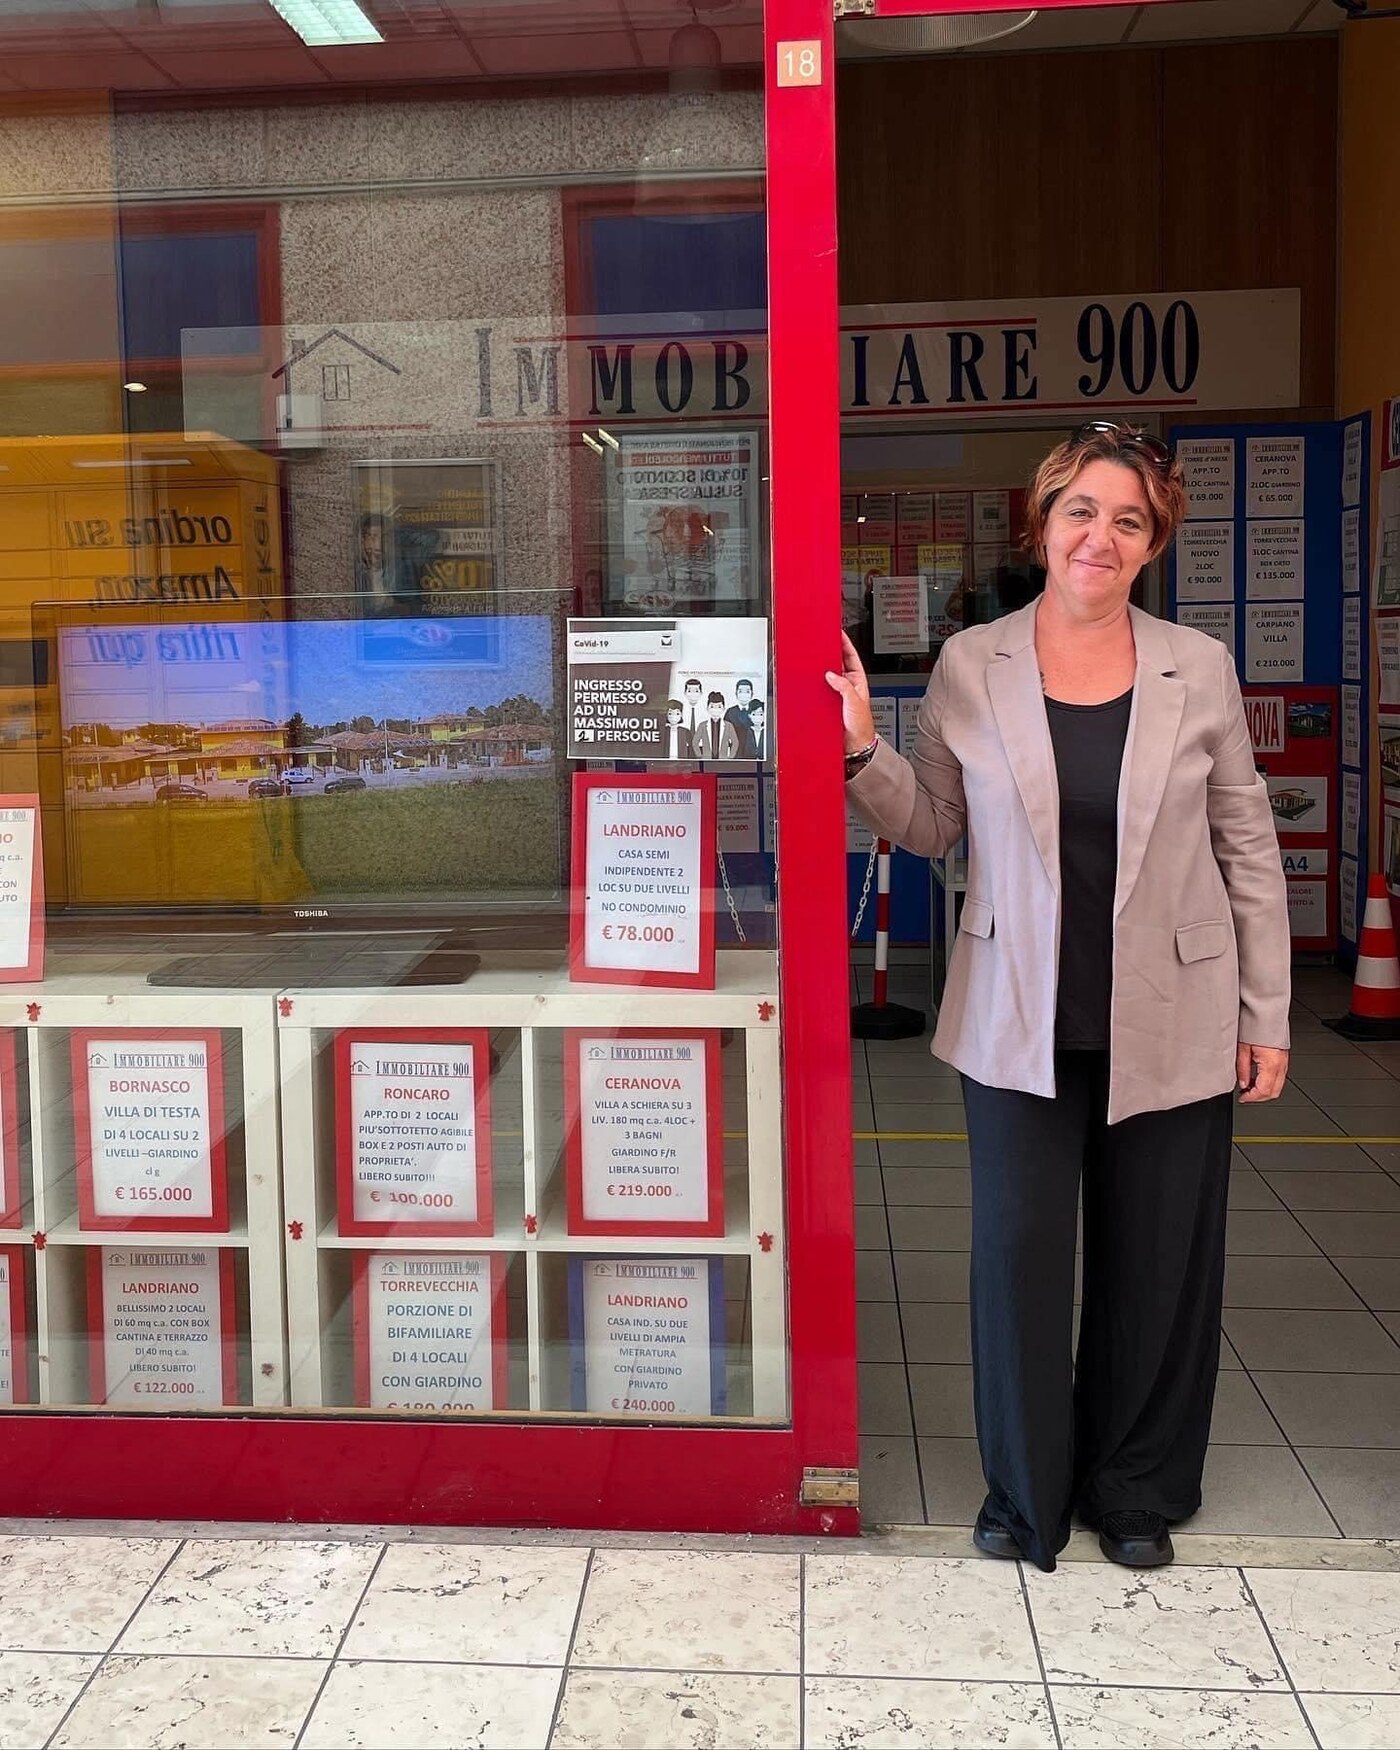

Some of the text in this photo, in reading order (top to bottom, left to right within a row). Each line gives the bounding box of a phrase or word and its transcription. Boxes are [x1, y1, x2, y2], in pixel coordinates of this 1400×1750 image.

[784, 49, 815, 77] 18
[474, 299, 1200, 418] IMMOBIARE 900
[1255, 455, 1296, 463] CERANOVA
[1191, 550, 1220, 558] NUOVO
[574, 640, 609, 648] CoVid-19
[574, 679, 643, 691] INGRESSO
[574, 692, 647, 704] PERMESSO
[573, 705, 617, 716] AD UN
[574, 718, 657, 729] MASSIMO DI
[597, 731, 660, 742] PERSONE
[617, 791, 692, 803] IMMOBILIARE 900
[603, 824, 687, 838] LANDRIANO
[618, 850, 670, 859] CASA SEMI
[1283, 855, 1309, 872] A4
[604, 867, 683, 877] INDIPENDENTE 2
[598, 883, 690, 894] LOC SU DUE LIVELLI
[601, 902, 686, 914] NO CONDOMINIO
[602, 926, 674, 942] € 78.000
[611, 1047, 691, 1059] IMMOBILIARE 900
[114, 1053, 204, 1068] IMMOBILIARE 900
[376, 1061, 469, 1075] IMMOBILIARE 900
[109, 1081, 190, 1093] BORNASCO
[605, 1078, 681, 1090] CERANOVA
[384, 1088, 450, 1100] RONCARO
[595, 1101, 619, 1109] VILLA
[622, 1101, 628, 1109] A
[631, 1101, 669, 1109] SCHIERA
[672, 1101, 684, 1109] SU
[104, 1106, 200, 1118] VILLA DI TESTA
[364, 1111, 459, 1120] APP.TO DI 2 LOCALI
[591, 1116, 608, 1125] LIV.
[611, 1117, 627, 1125] 180
[629, 1118, 644, 1126] mq
[664, 1117, 688, 1125] 4LOC
[104, 1130, 199, 1140] DI 4 LOCALI SU 2
[440, 1128, 473, 1136] AGIBILE
[625, 1131, 662, 1139] 3 BAGNI
[359, 1142, 466, 1151] BOX E 2 POSTI AUTO DI
[105, 1149, 139, 1157] LIVELLI
[612, 1149, 676, 1158] GIARDINO F/R
[608, 1166, 679, 1174] LIBERA SUBITO!
[359, 1172, 392, 1181] LIBERO
[115, 1187, 192, 1200] € 165.000
[607, 1185, 672, 1196] € 219.000
[370, 1191, 453, 1207] € 100.000
[192, 1253, 205, 1264] 900
[681, 1267, 695, 1277] 900
[122, 1283, 199, 1293] LANDRIANO
[381, 1281, 478, 1292] TORREVECCHIA
[608, 1295, 688, 1308] LANDRIANO
[387, 1305, 472, 1316] PORZIONE DI
[608, 1318, 688, 1328] CASA IND. SU DUE
[164, 1334, 208, 1342] TERRAZZO
[388, 1328, 472, 1338] BIFAMILIARE
[610, 1334, 686, 1343] LIVELLI DI AMPIA
[393, 1352, 467, 1363] DI 4 LOCALI
[620, 1348, 676, 1358] METRATURA
[129, 1364, 159, 1372] LIBERO
[614, 1365, 682, 1375] CON GIARDINO
[382, 1376, 482, 1388] CON GIARDINO
[629, 1380, 668, 1389] PRIVATO
[134, 1383, 194, 1393] € 122.000
[611, 1398, 675, 1412] € 240.000
